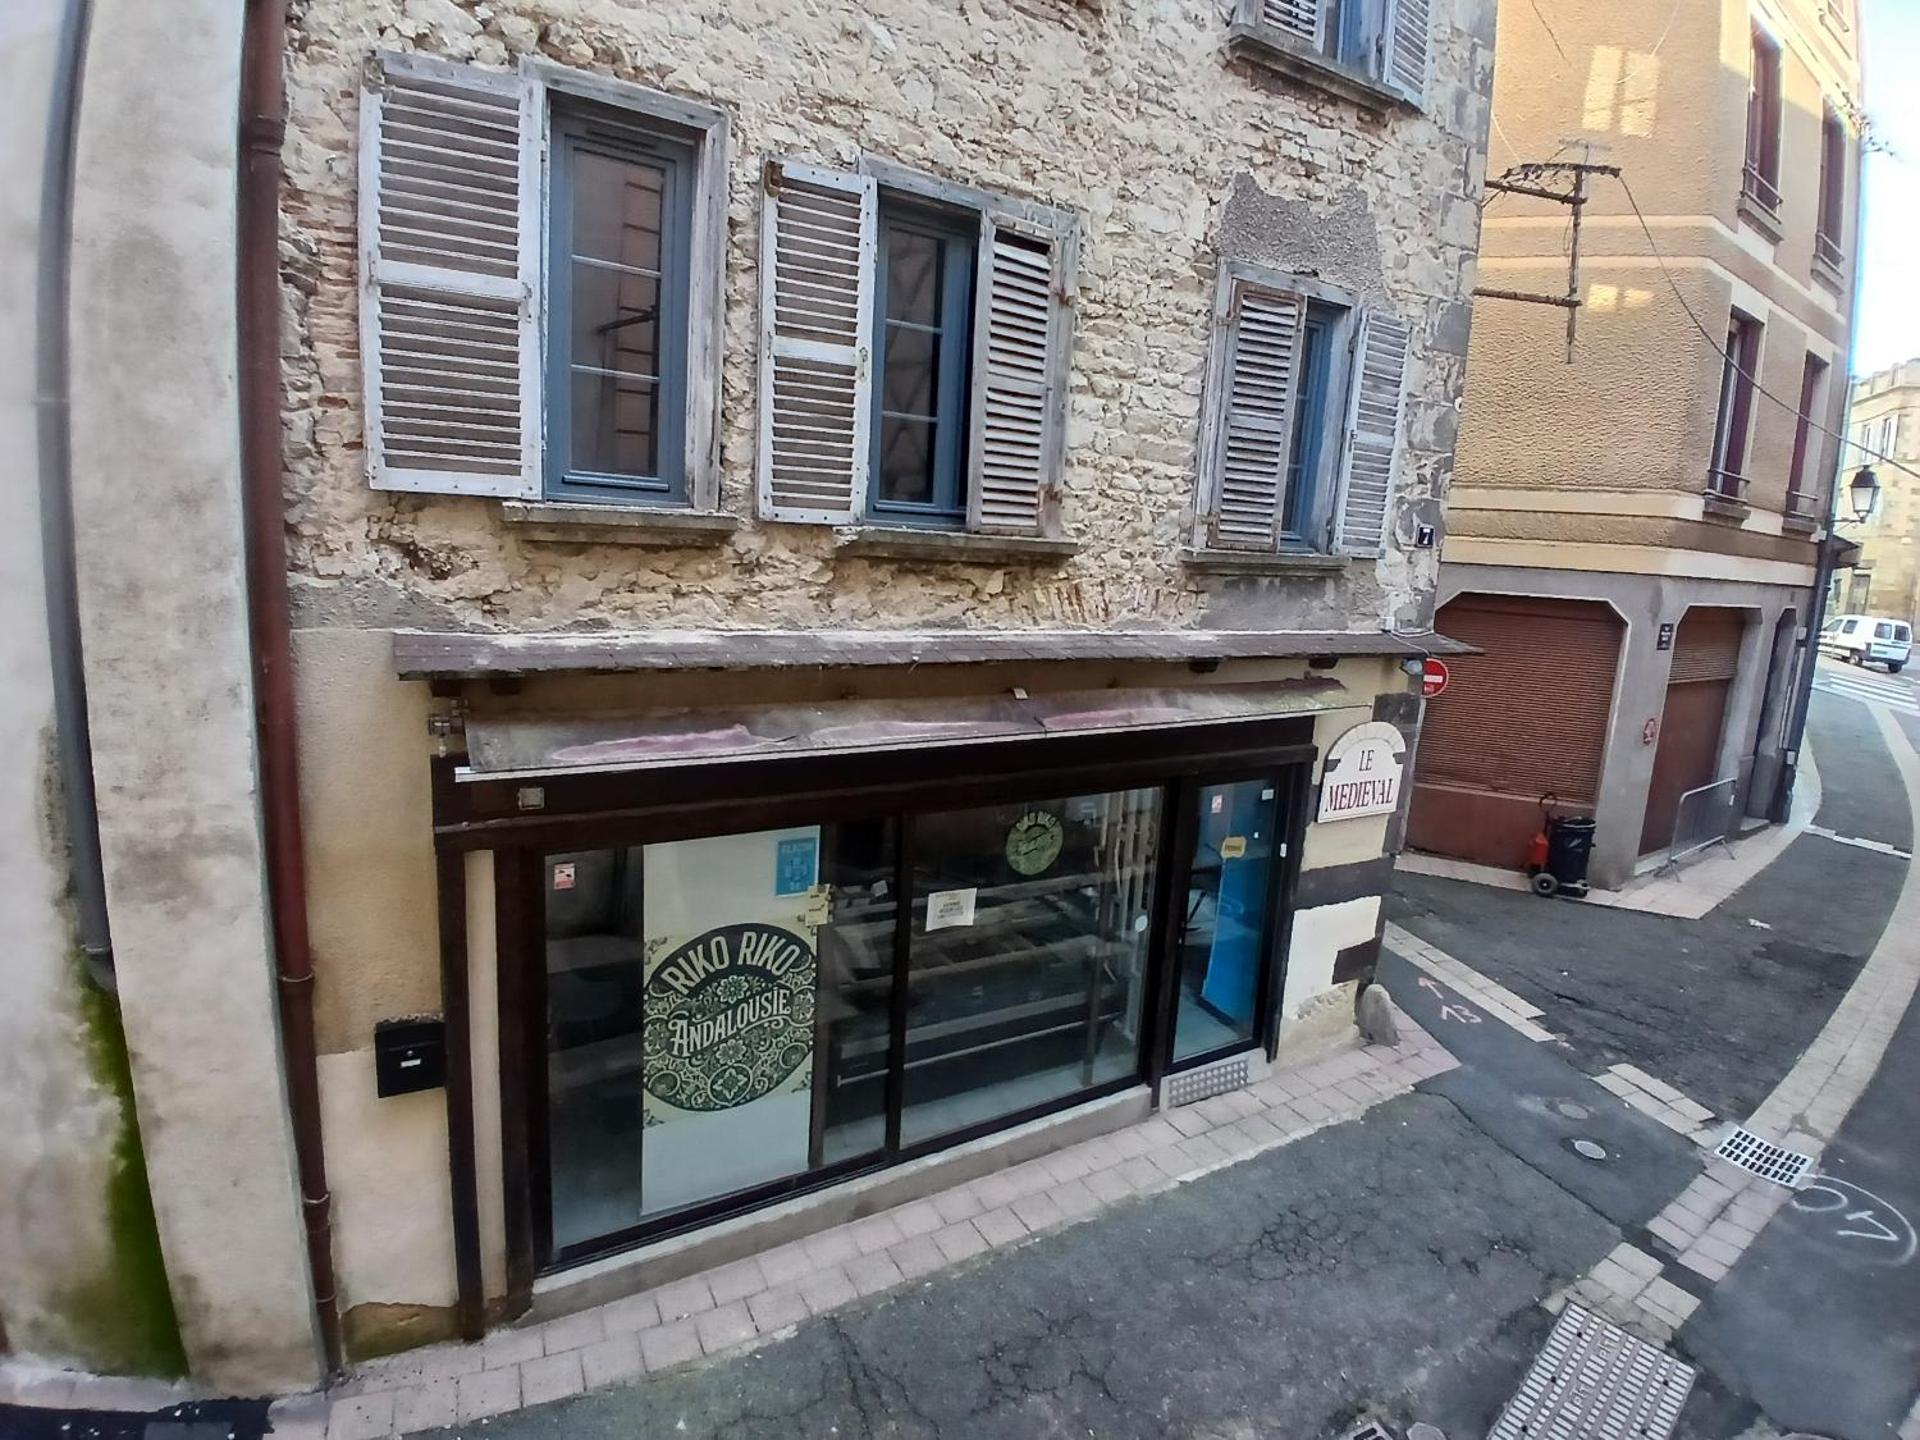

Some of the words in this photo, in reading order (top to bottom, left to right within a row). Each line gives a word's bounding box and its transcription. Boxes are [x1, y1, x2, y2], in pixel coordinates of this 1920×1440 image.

[1423, 528, 1431, 545] 7
[1359, 749, 1375, 771] LE
[1325, 778, 1394, 813] MEDIEVAL
[661, 935, 730, 996] RIKO
[738, 930, 800, 976] RIKO
[668, 986, 791, 1059] ANDALOUSIE
